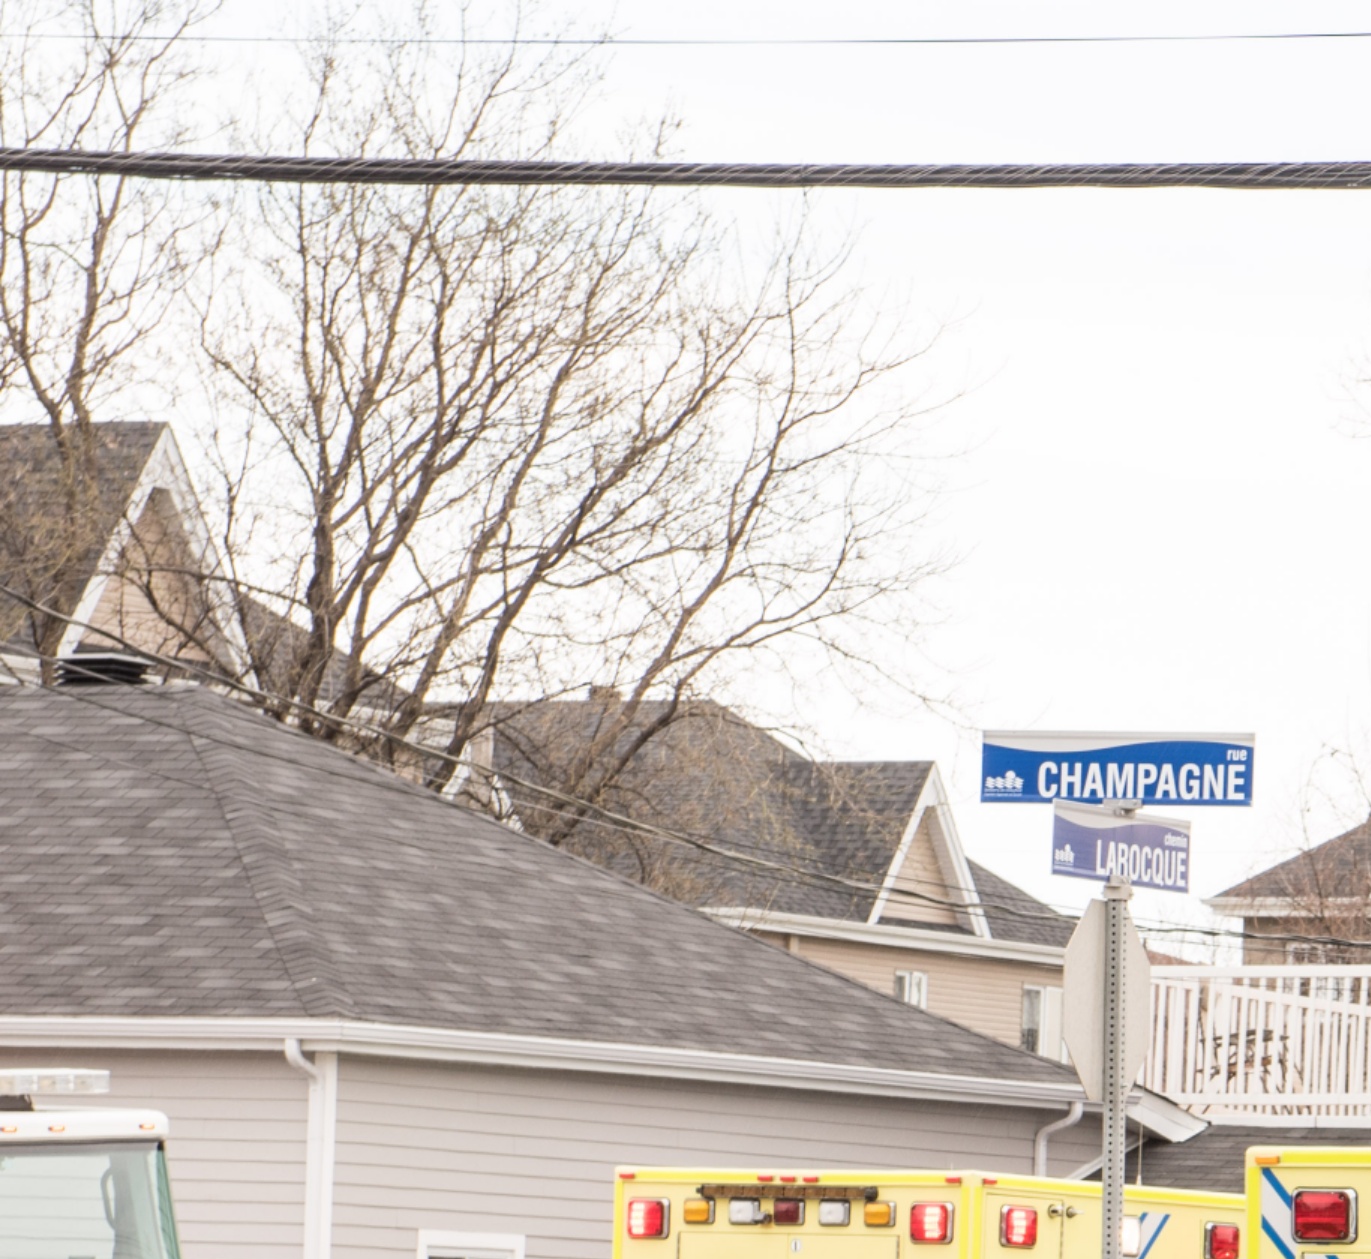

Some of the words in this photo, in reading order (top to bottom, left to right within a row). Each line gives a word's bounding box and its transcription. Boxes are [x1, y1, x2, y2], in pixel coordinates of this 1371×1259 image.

[1227, 749, 1247, 761] rue
[1037, 761, 1246, 800] CHAMPAGNE
[1164, 832, 1188, 848] chemin
[1096, 839, 1187, 886] LAROCQUE
